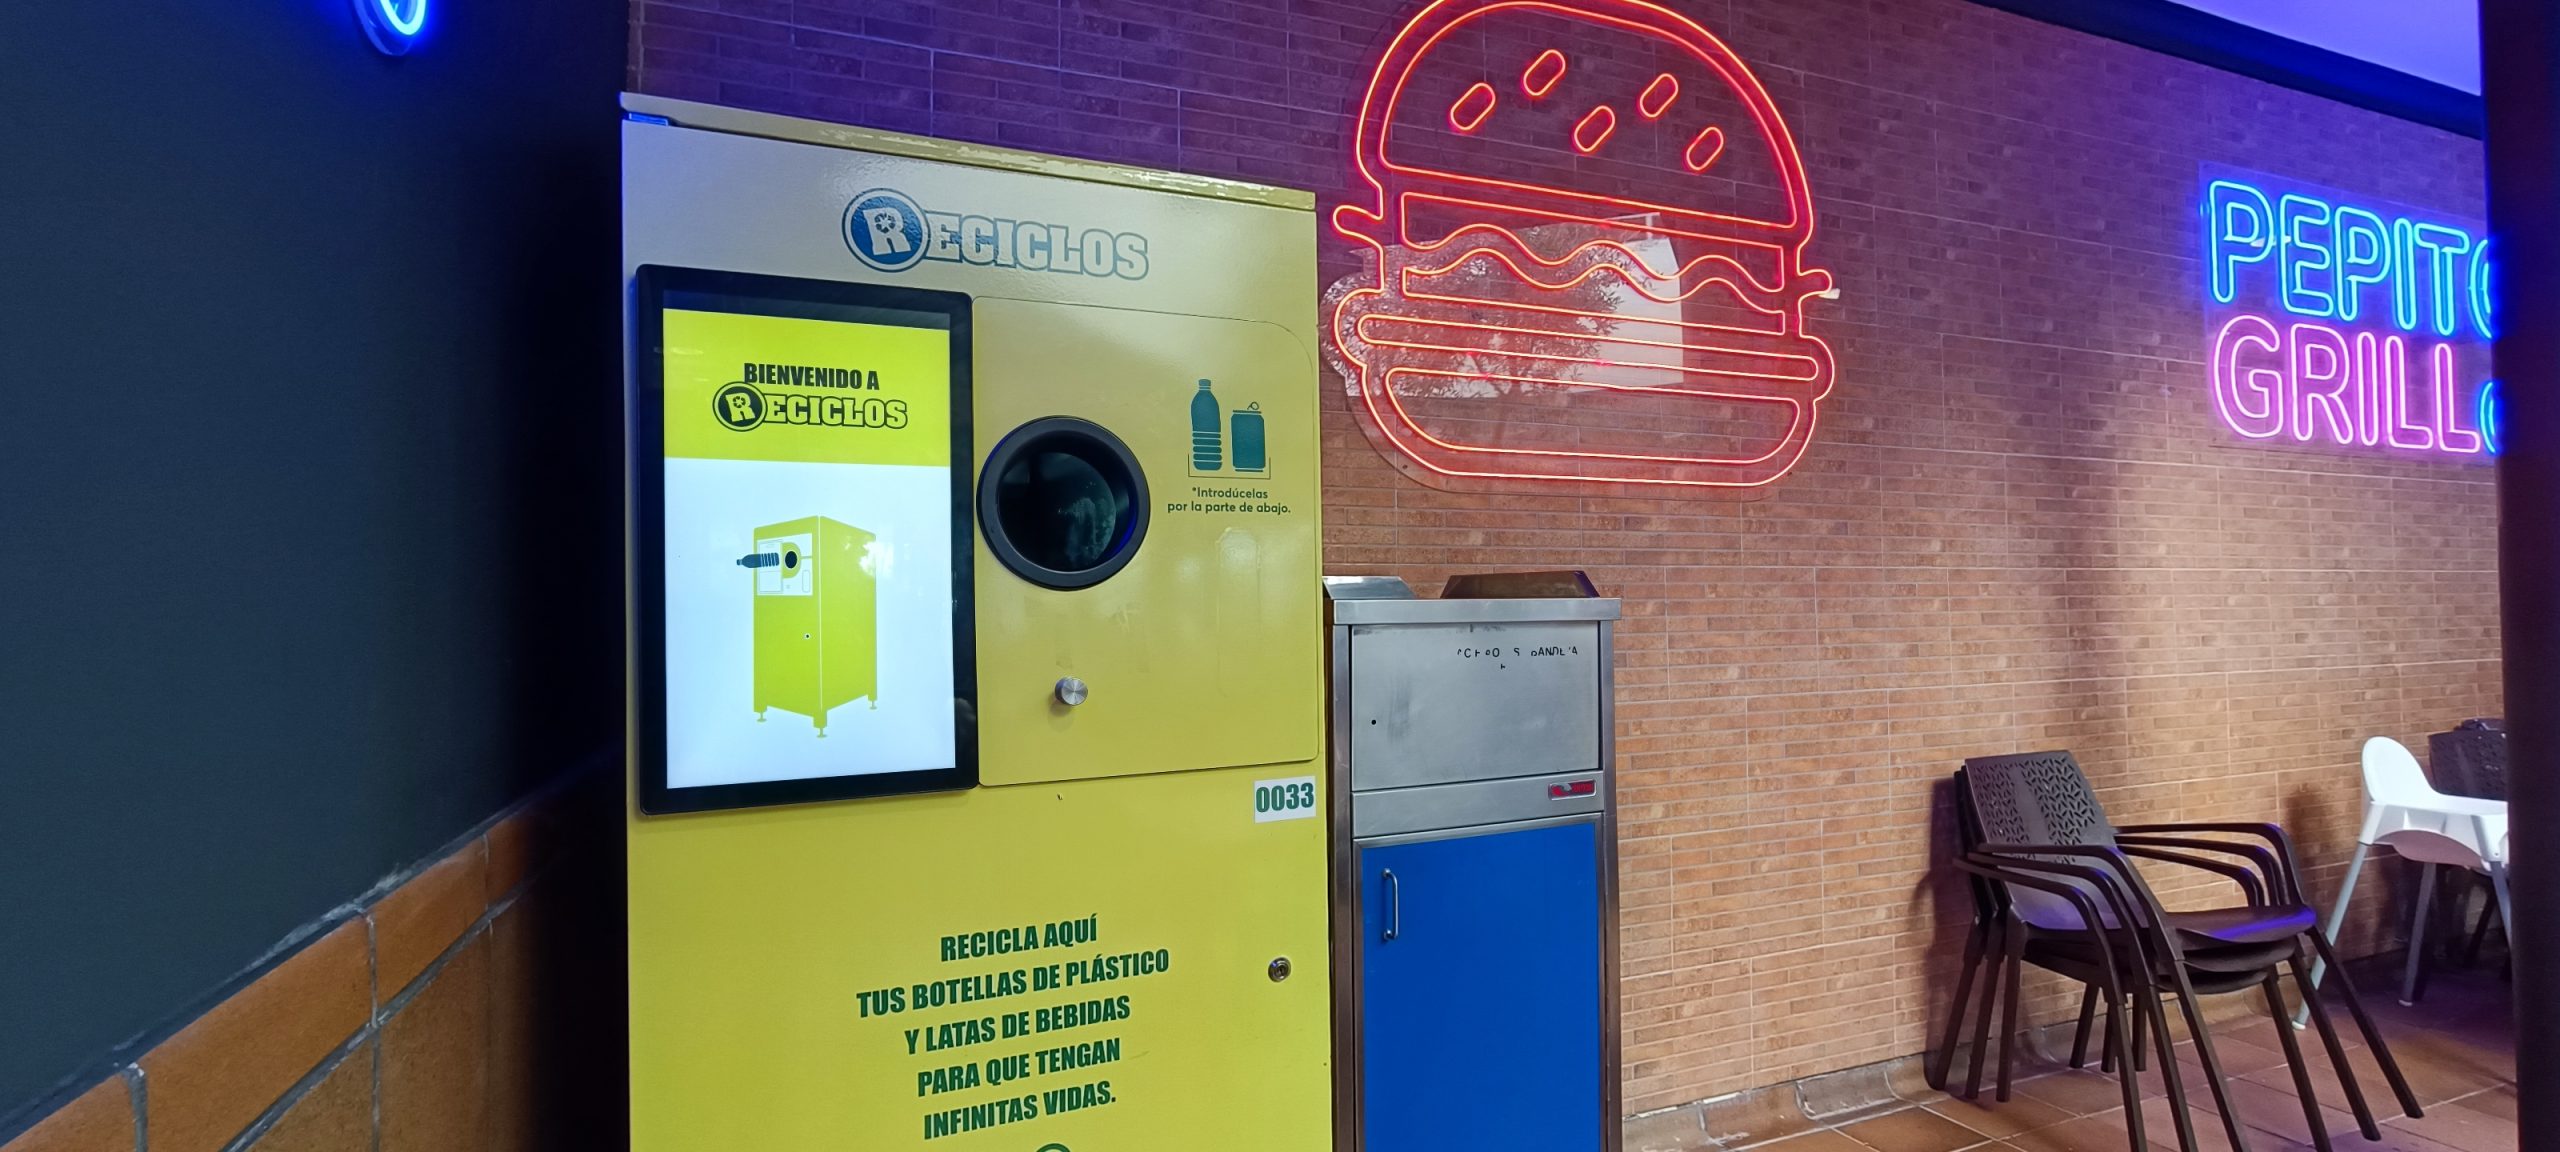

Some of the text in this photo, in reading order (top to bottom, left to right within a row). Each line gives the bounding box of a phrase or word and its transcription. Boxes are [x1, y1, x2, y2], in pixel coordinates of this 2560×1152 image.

[842, 188, 1150, 281] RECICLOS
[743, 363, 880, 391] BIENVENIDO A
[712, 381, 908, 432] RECICLOS
[1167, 501, 1291, 515] por la parte de abajo.
[1255, 782, 1315, 813] 0033
[940, 913, 1098, 961] RECICLA AQUÍ
[857, 948, 1170, 1018] TUS BOTELLAS DE PLÁSTICO
[904, 995, 1131, 1055] Y LATAS DE BEBIDAS
[918, 1038, 1121, 1097] PARA QUE TENGAN
[924, 1080, 1116, 1139] INFINITAS VIDAS.
